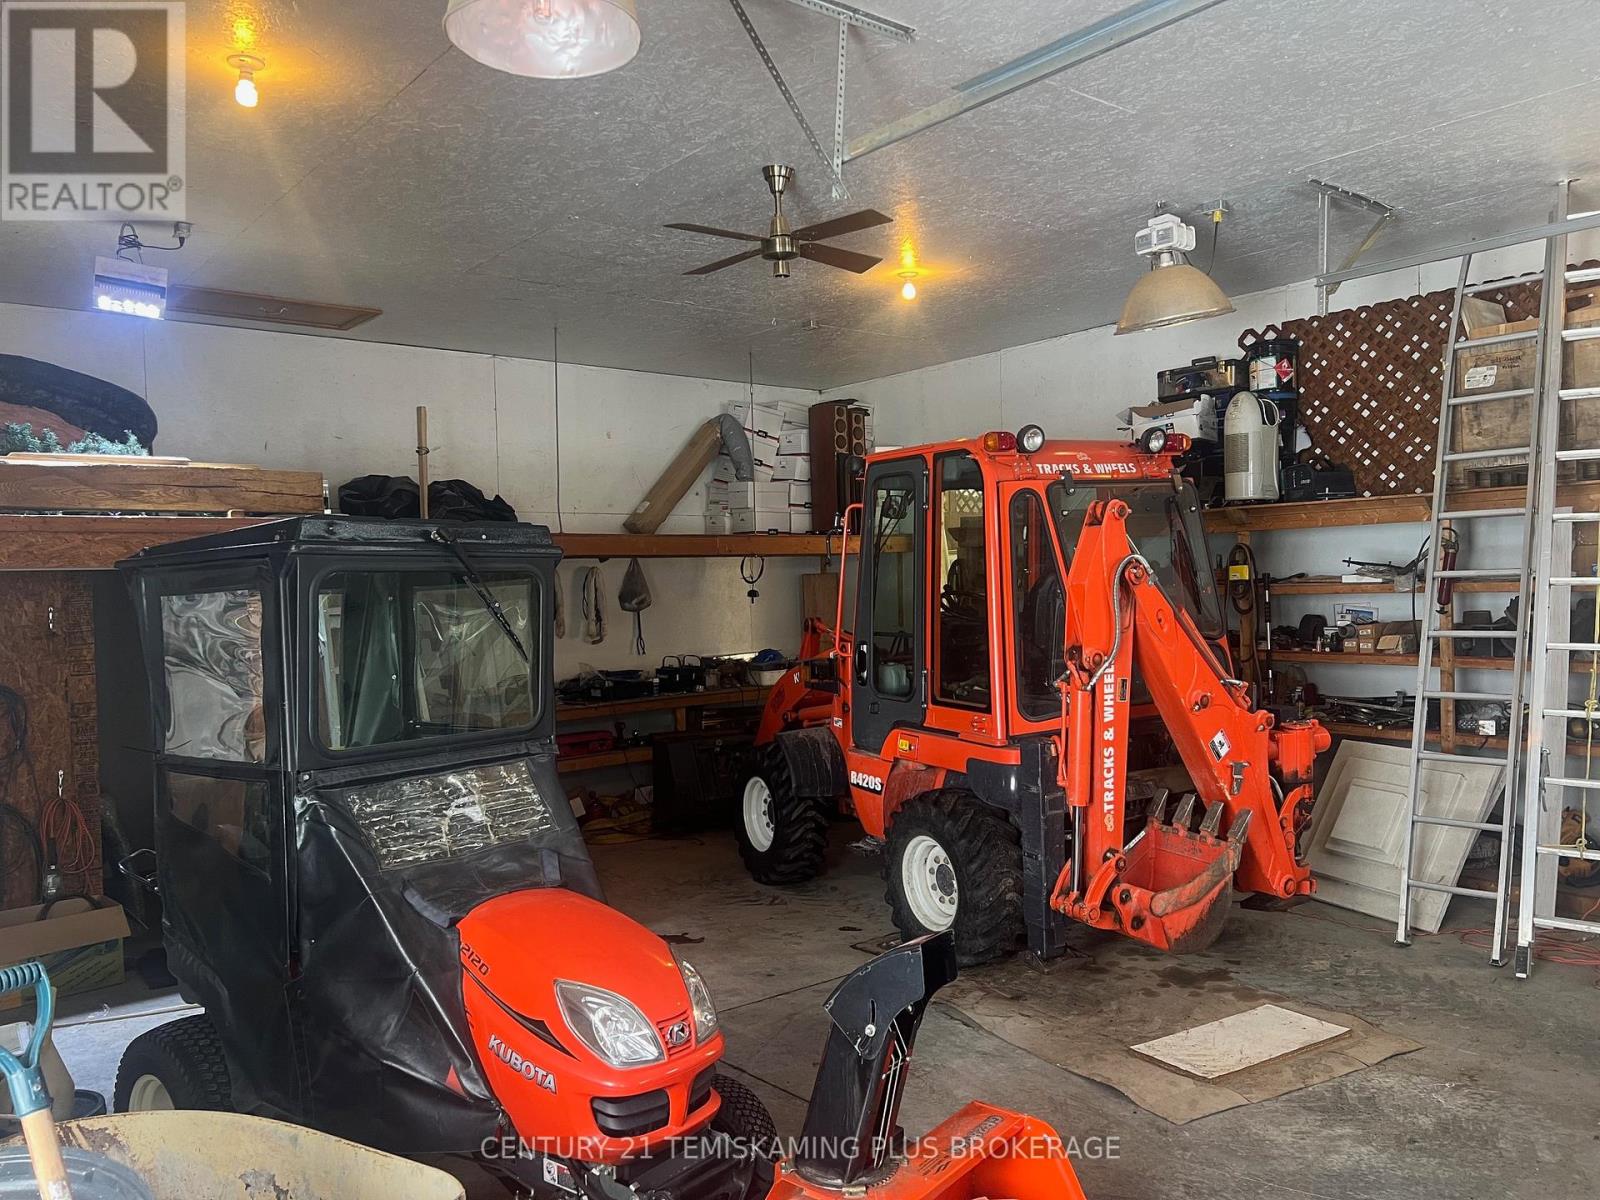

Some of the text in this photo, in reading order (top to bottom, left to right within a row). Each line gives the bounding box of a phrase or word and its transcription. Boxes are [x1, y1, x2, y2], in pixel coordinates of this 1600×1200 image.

[1036, 462, 1137, 474] TRACKS & WHEELS
[1103, 727, 1115, 741] &
[850, 770, 882, 791] R420S
[1103, 746, 1115, 813] TRACKS
[488, 1034, 557, 1095] KUBOTA
